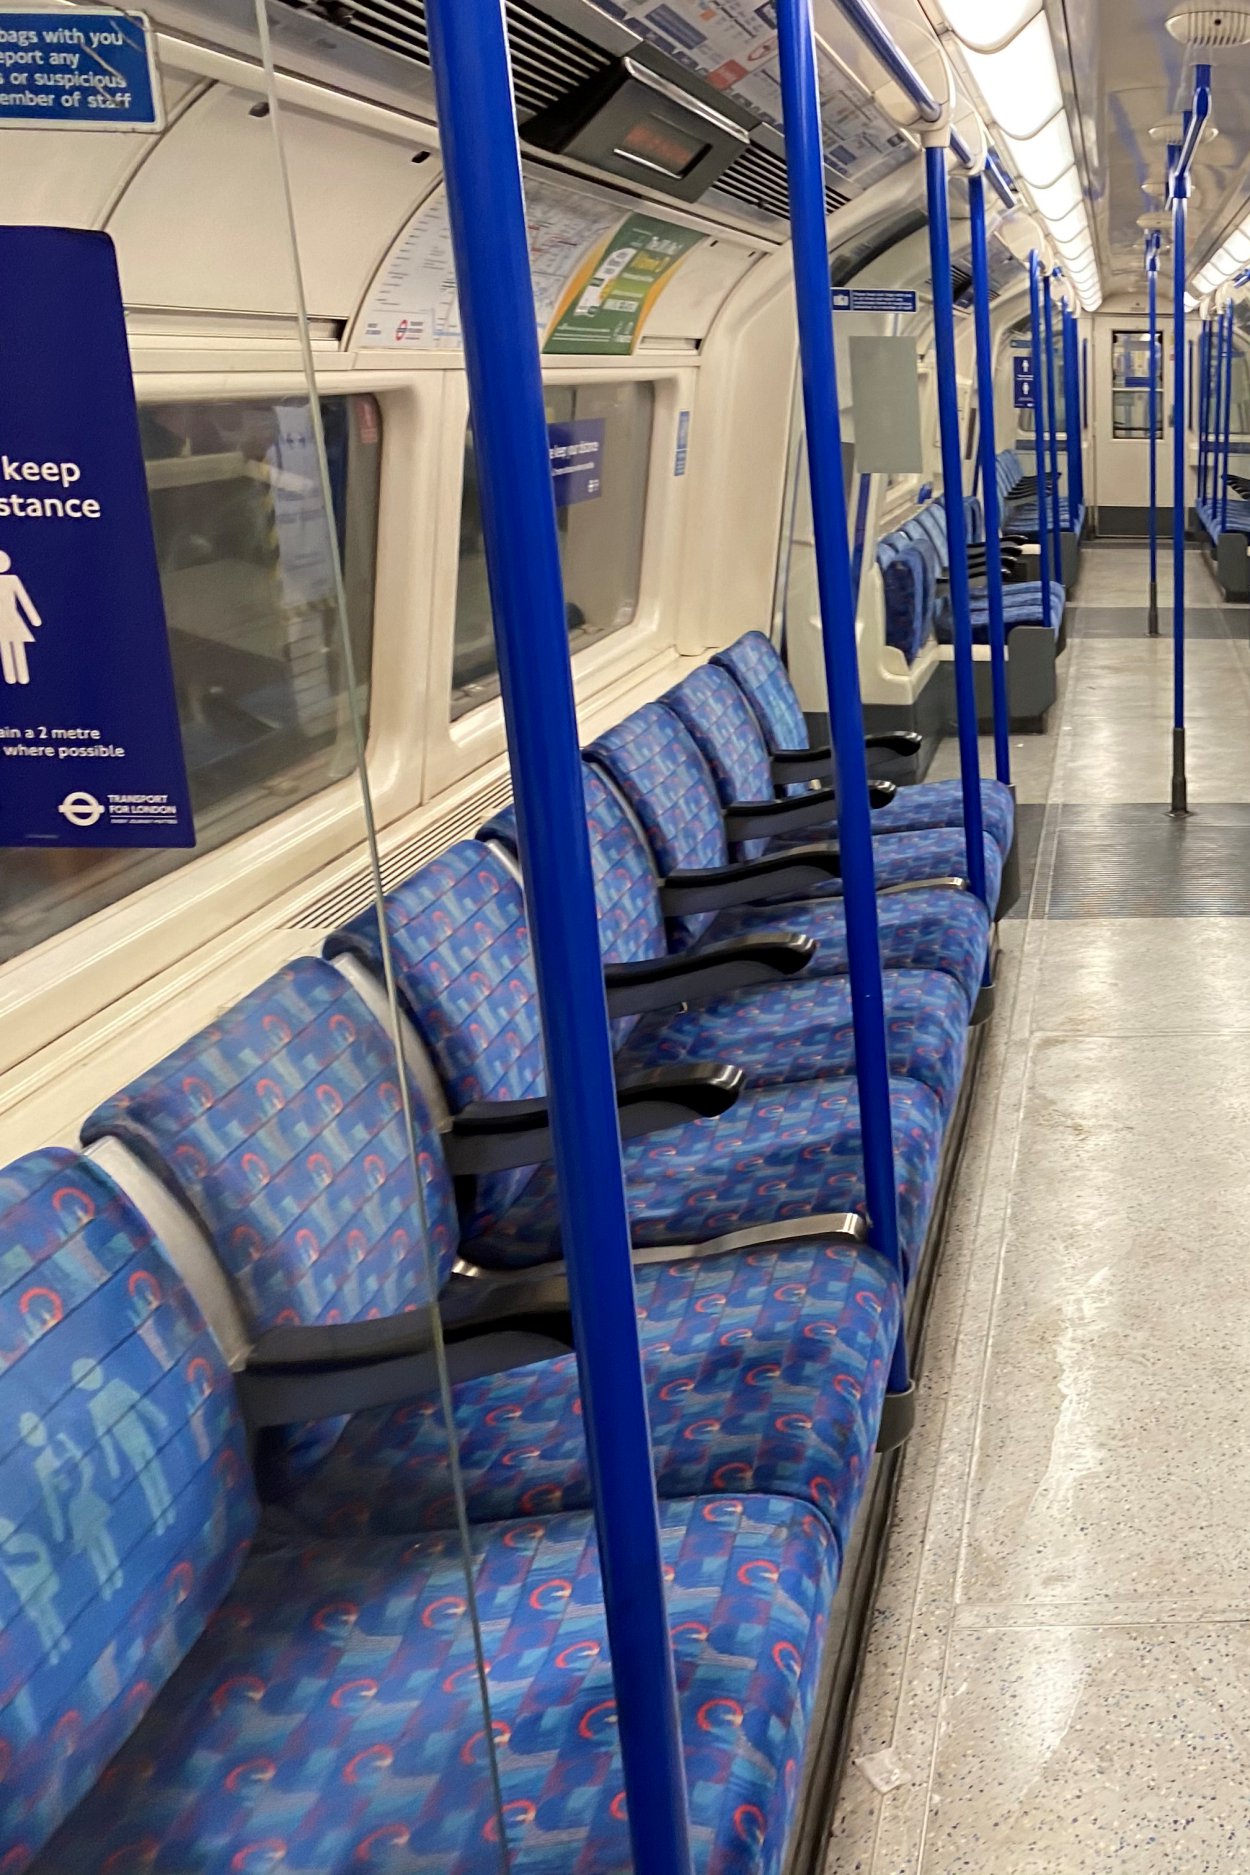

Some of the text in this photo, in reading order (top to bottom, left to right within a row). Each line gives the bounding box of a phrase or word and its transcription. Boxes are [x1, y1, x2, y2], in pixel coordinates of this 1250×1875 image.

[42, 28, 85, 44] with
[90, 32, 123, 48] you
[49, 52, 80, 68] any
[10, 72, 28, 85] or
[34, 71, 127, 90] suspicious
[0, 90, 132, 109] ember of staff
[1, 455, 81, 488] keep
[0, 494, 101, 518] stance
[25, 728, 35, 739] a
[37, 726, 48, 739] 2
[51, 728, 101, 740] metre
[3, 744, 126, 760] where possible
[107, 794, 168, 803] TRANSPORT
[109, 805, 177, 814] FOR LONDON
